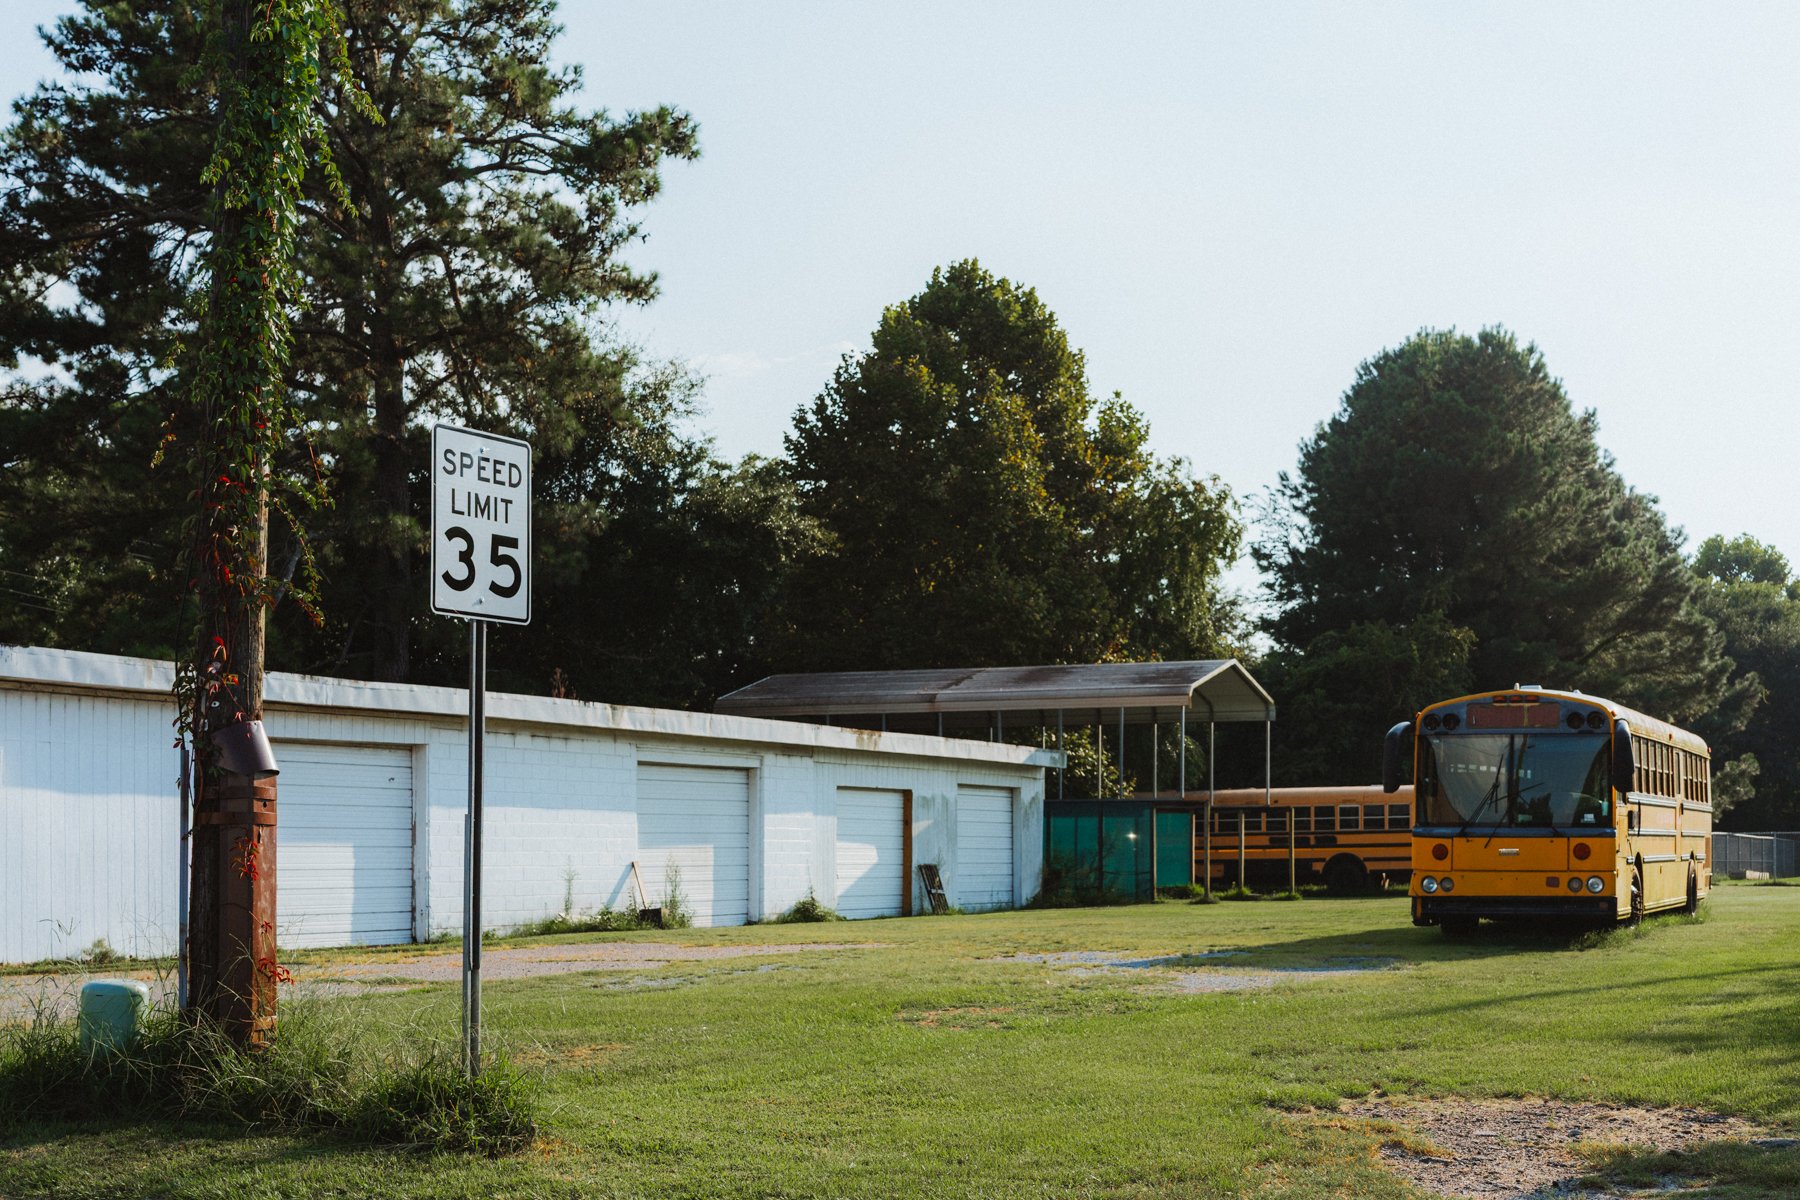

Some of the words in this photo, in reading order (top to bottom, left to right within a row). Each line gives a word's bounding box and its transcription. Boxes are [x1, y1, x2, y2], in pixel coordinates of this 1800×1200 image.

[442, 448, 522, 489] SPEED
[451, 488, 513, 524] LIMIT
[441, 526, 522, 599] 35
